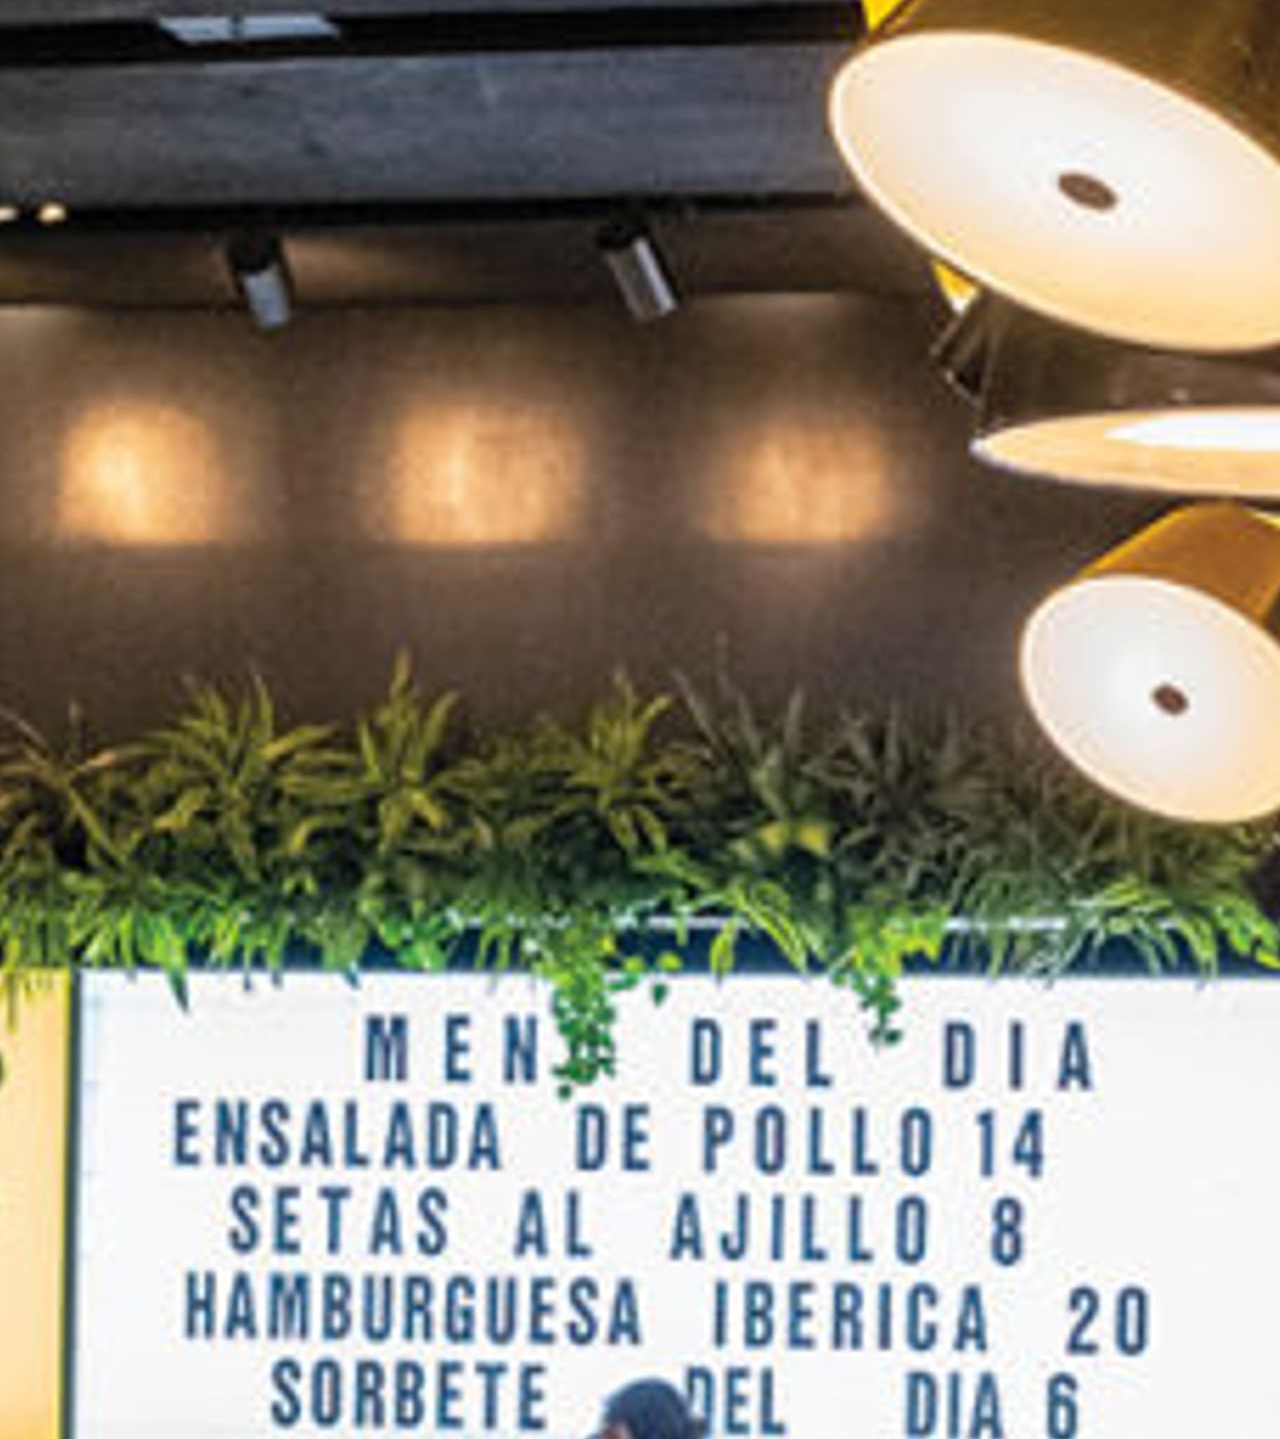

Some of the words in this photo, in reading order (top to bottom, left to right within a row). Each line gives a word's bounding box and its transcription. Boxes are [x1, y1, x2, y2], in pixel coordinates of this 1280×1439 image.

[365, 1015, 538, 1083] MEN
[691, 1018, 832, 1088] DEL
[943, 1021, 1092, 1090] DIA
[174, 1099, 501, 1170] ENSALADA
[576, 1104, 650, 1172] DE
[703, 1105, 933, 1176] POLLO
[976, 1109, 1044, 1178] 14
[229, 1185, 448, 1256] SETAS
[514, 1190, 592, 1258] AL
[670, 1193, 928, 1265] AJILLO
[991, 1196, 1024, 1267] 8
[185, 1271, 641, 1346] HAMBURGUESA
[714, 1280, 988, 1352] IBERICA
[1066, 1286, 1148, 1357] 20
[270, 1357, 546, 1431] SORBETE
[687, 1366, 786, 1438] DEL
